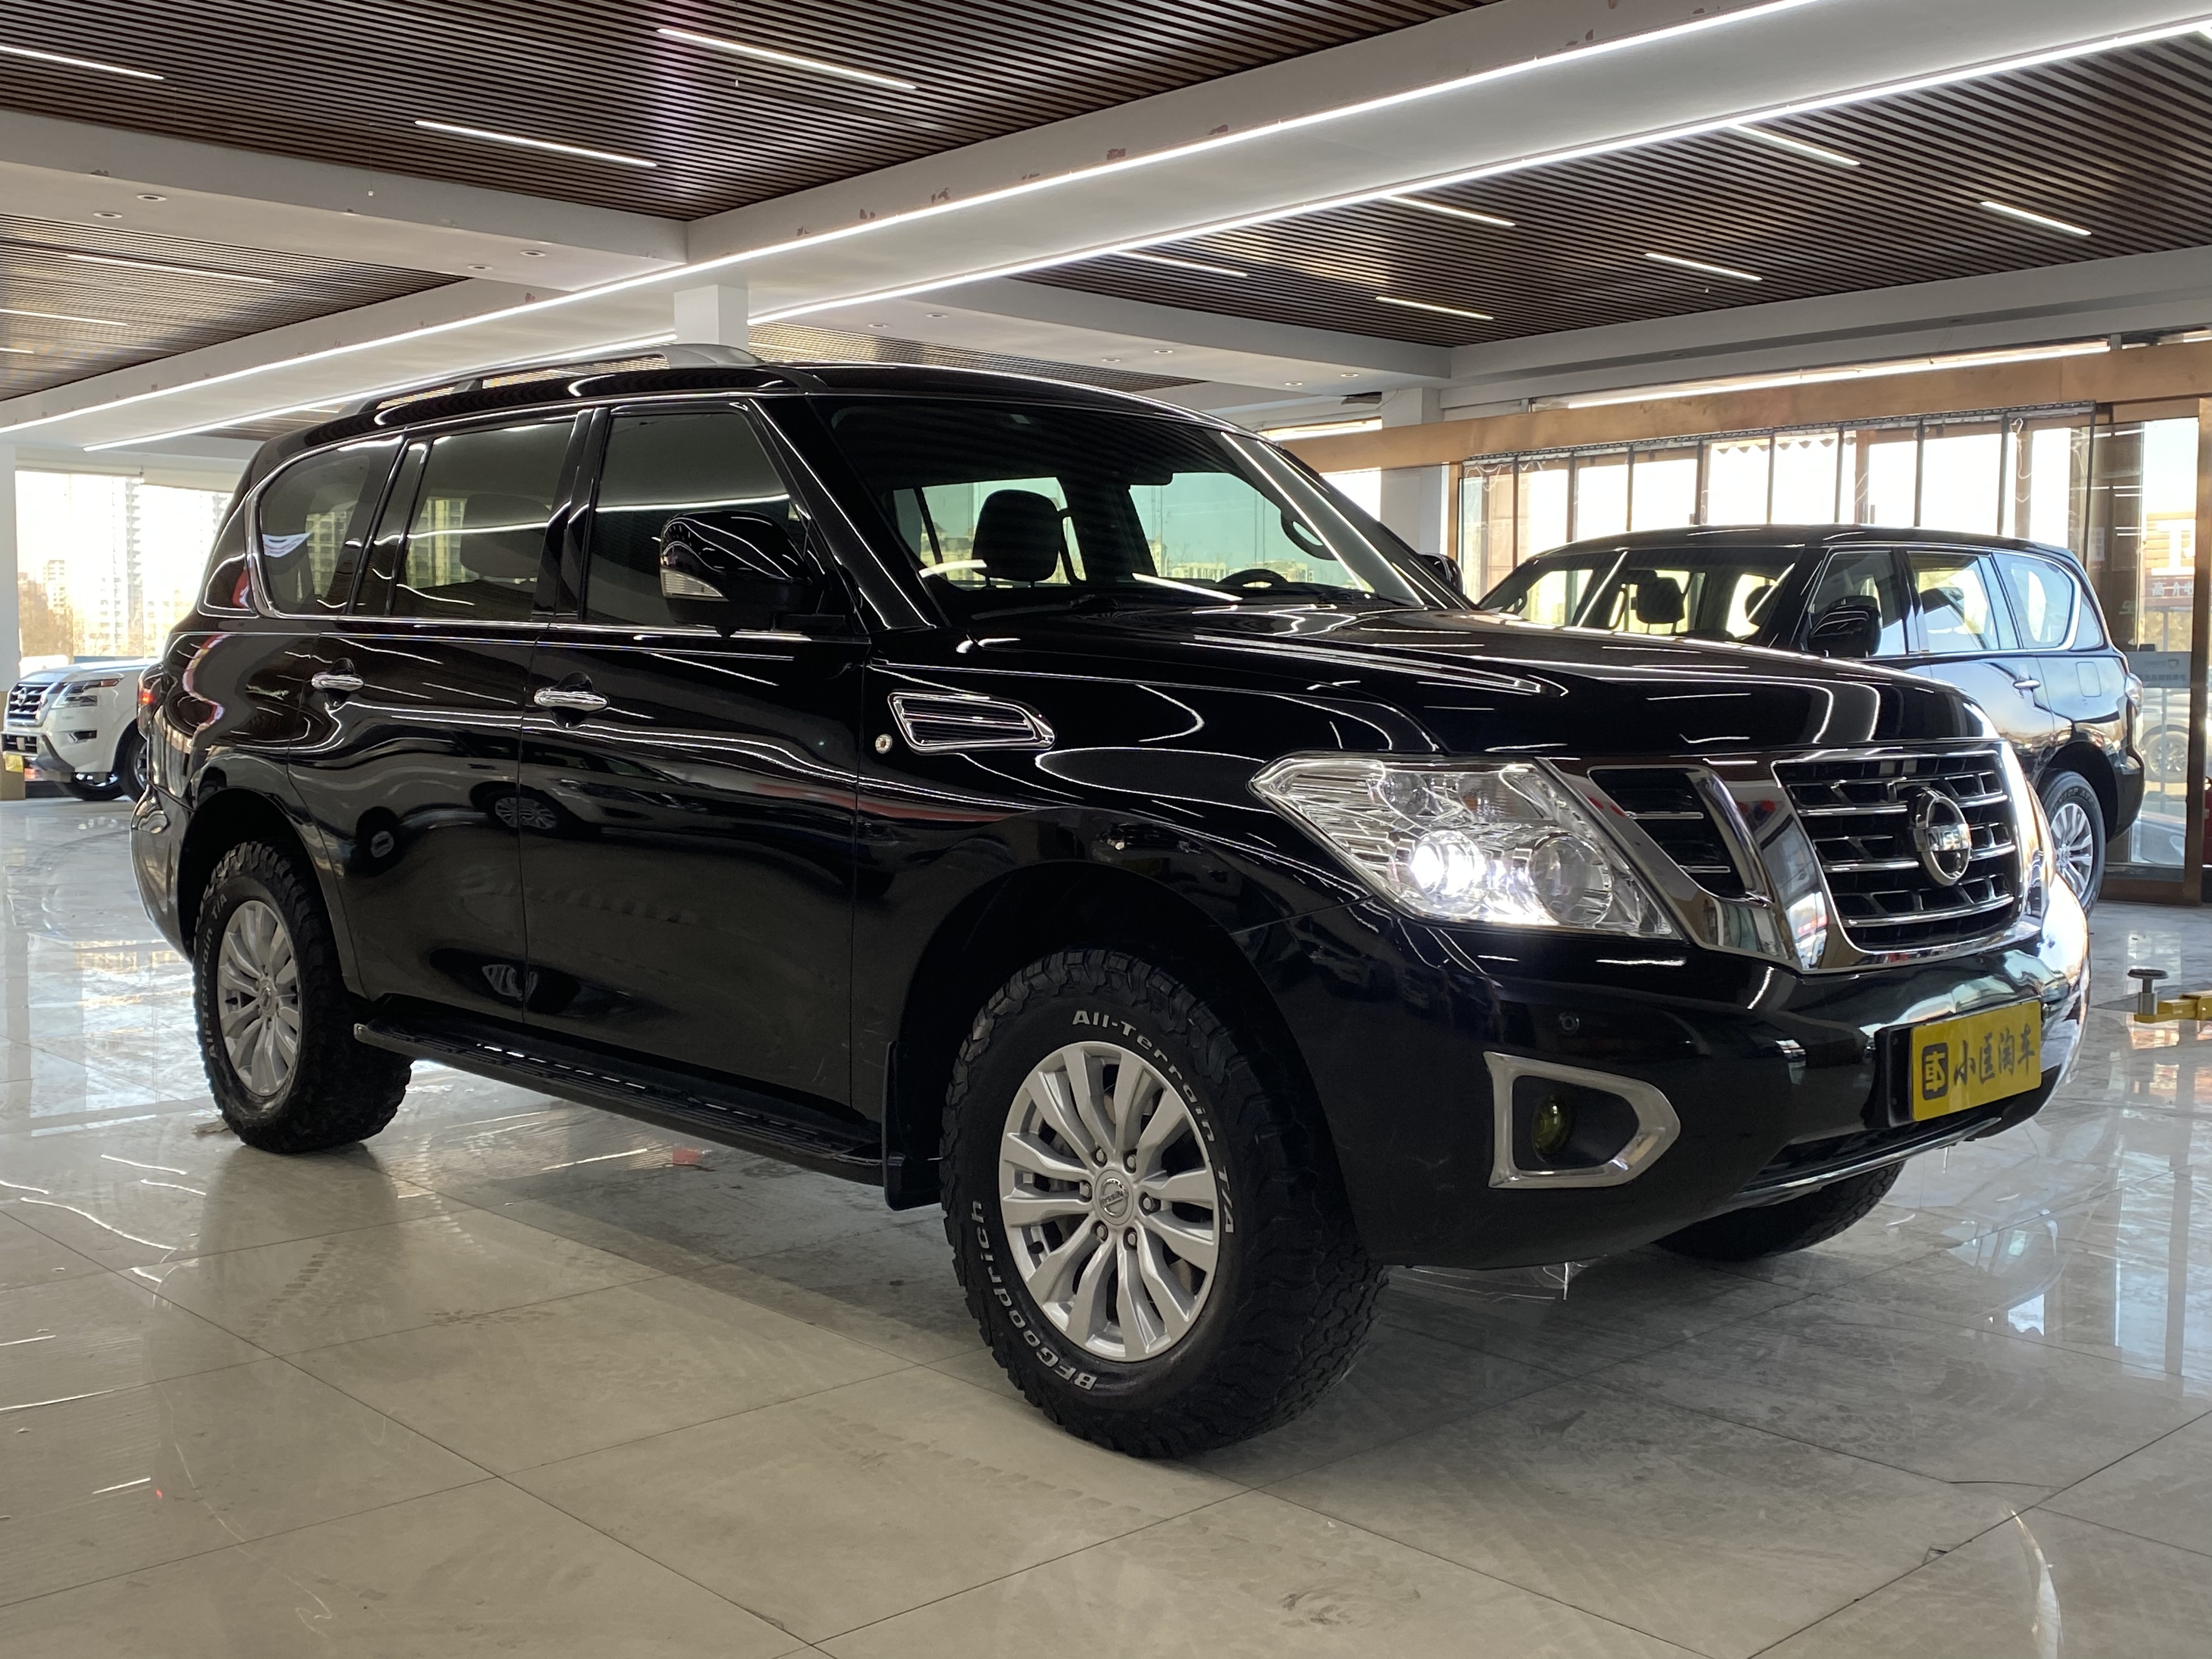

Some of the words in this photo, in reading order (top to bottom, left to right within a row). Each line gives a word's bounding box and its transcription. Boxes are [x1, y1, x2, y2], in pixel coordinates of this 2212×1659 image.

[1072, 1010, 1215, 1142] All-Terrain
[1218, 1165, 1234, 1233] T/A
[971, 1200, 1097, 1391] BFGoodrich
